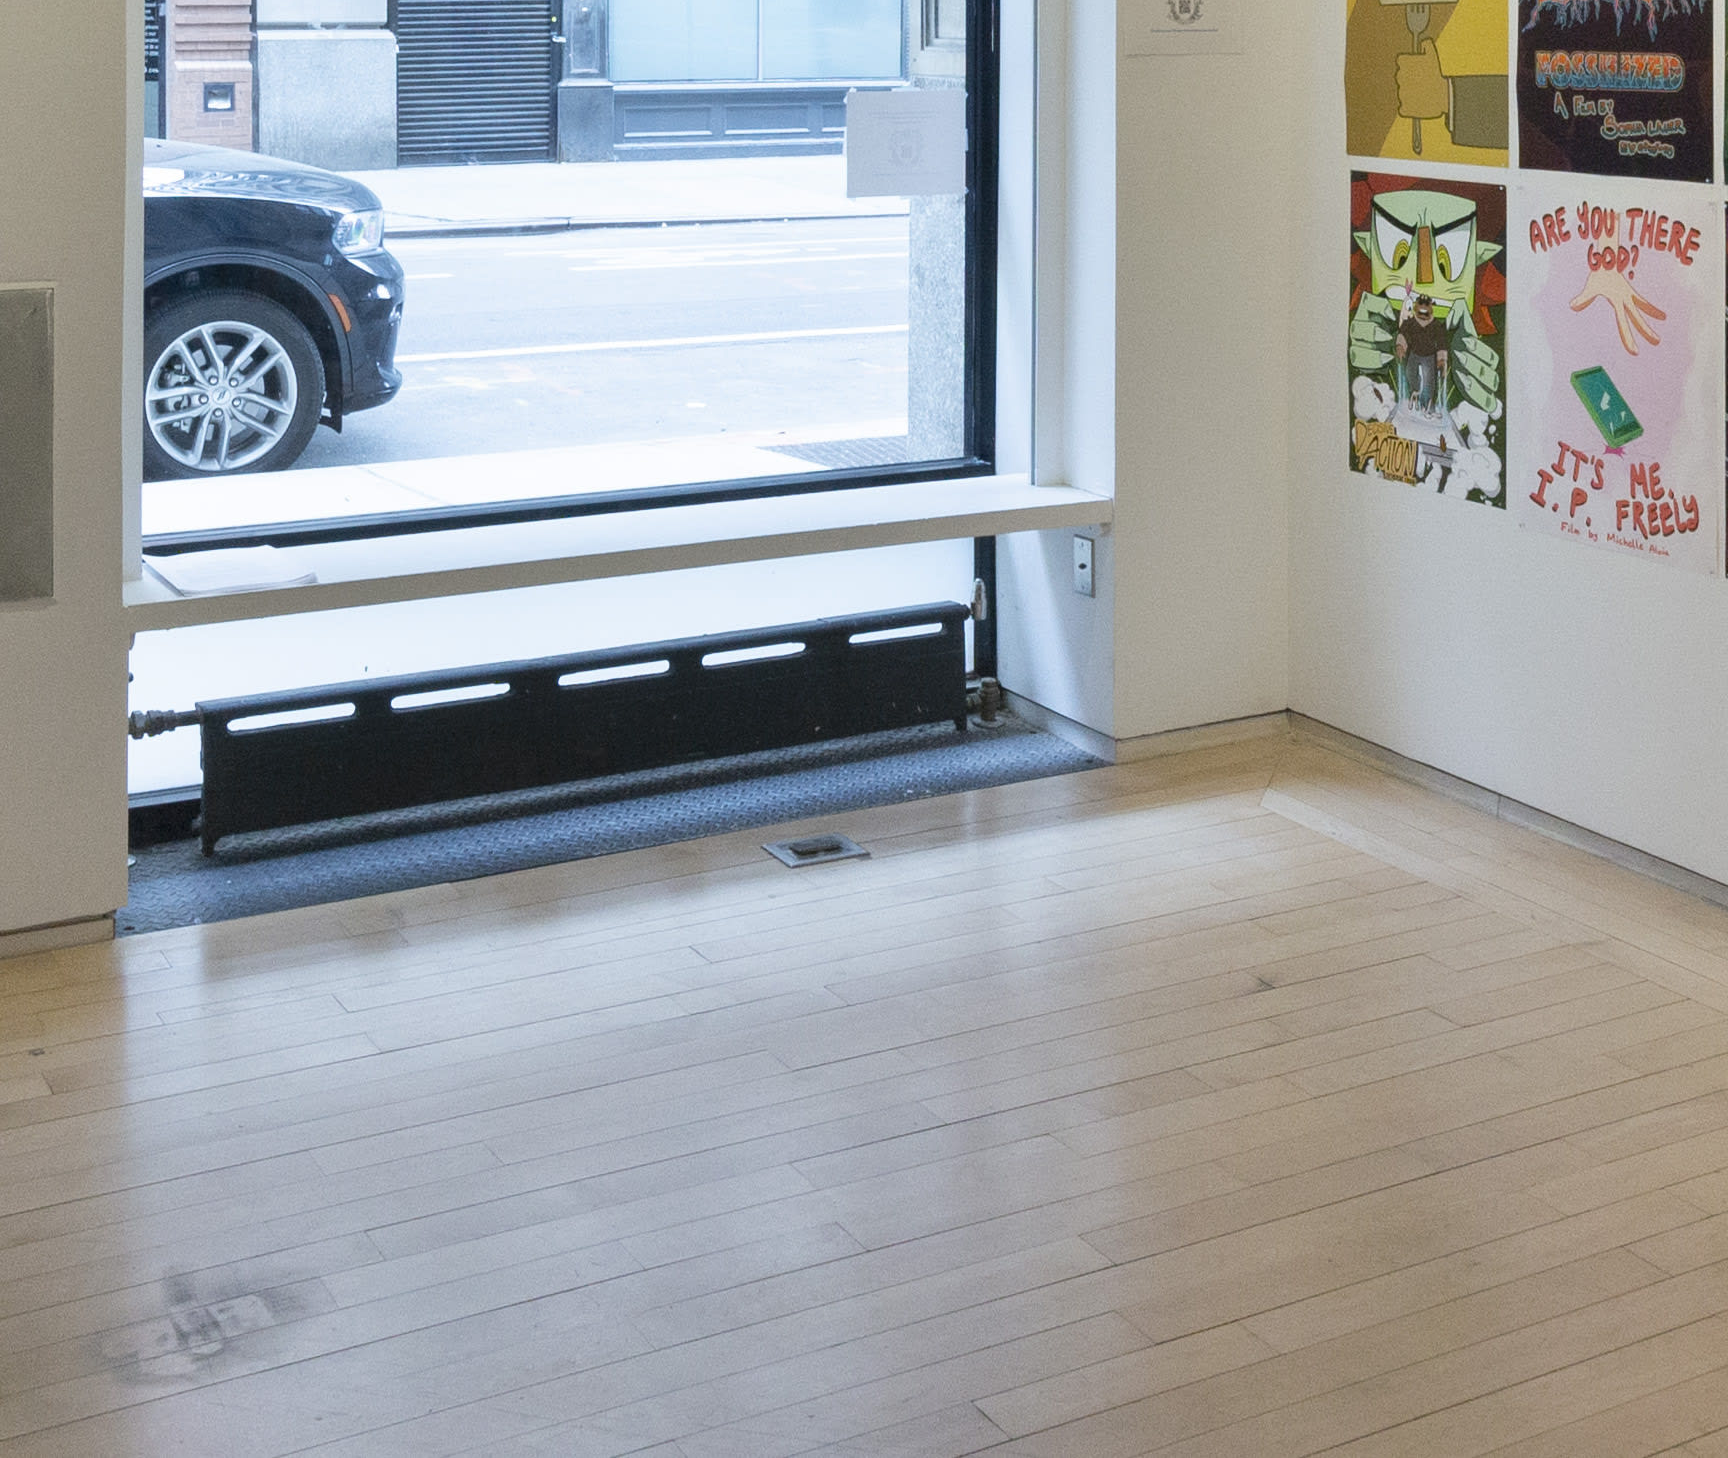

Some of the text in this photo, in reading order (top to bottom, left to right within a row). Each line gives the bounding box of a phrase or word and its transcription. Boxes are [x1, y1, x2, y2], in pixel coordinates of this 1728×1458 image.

[1554, 92, 1569, 119] A
[1598, 99, 1614, 115] BY
[1530, 201, 1701, 265] ARE YOU THERE
[1587, 243, 1639, 280] GOD?
[1551, 441, 1604, 490] IT'S
[1560, 521, 1580, 535] Film
[1588, 529, 1598, 542] by
[1606, 533, 1644, 551] Michelle
[1616, 495, 1700, 540] FREELY
